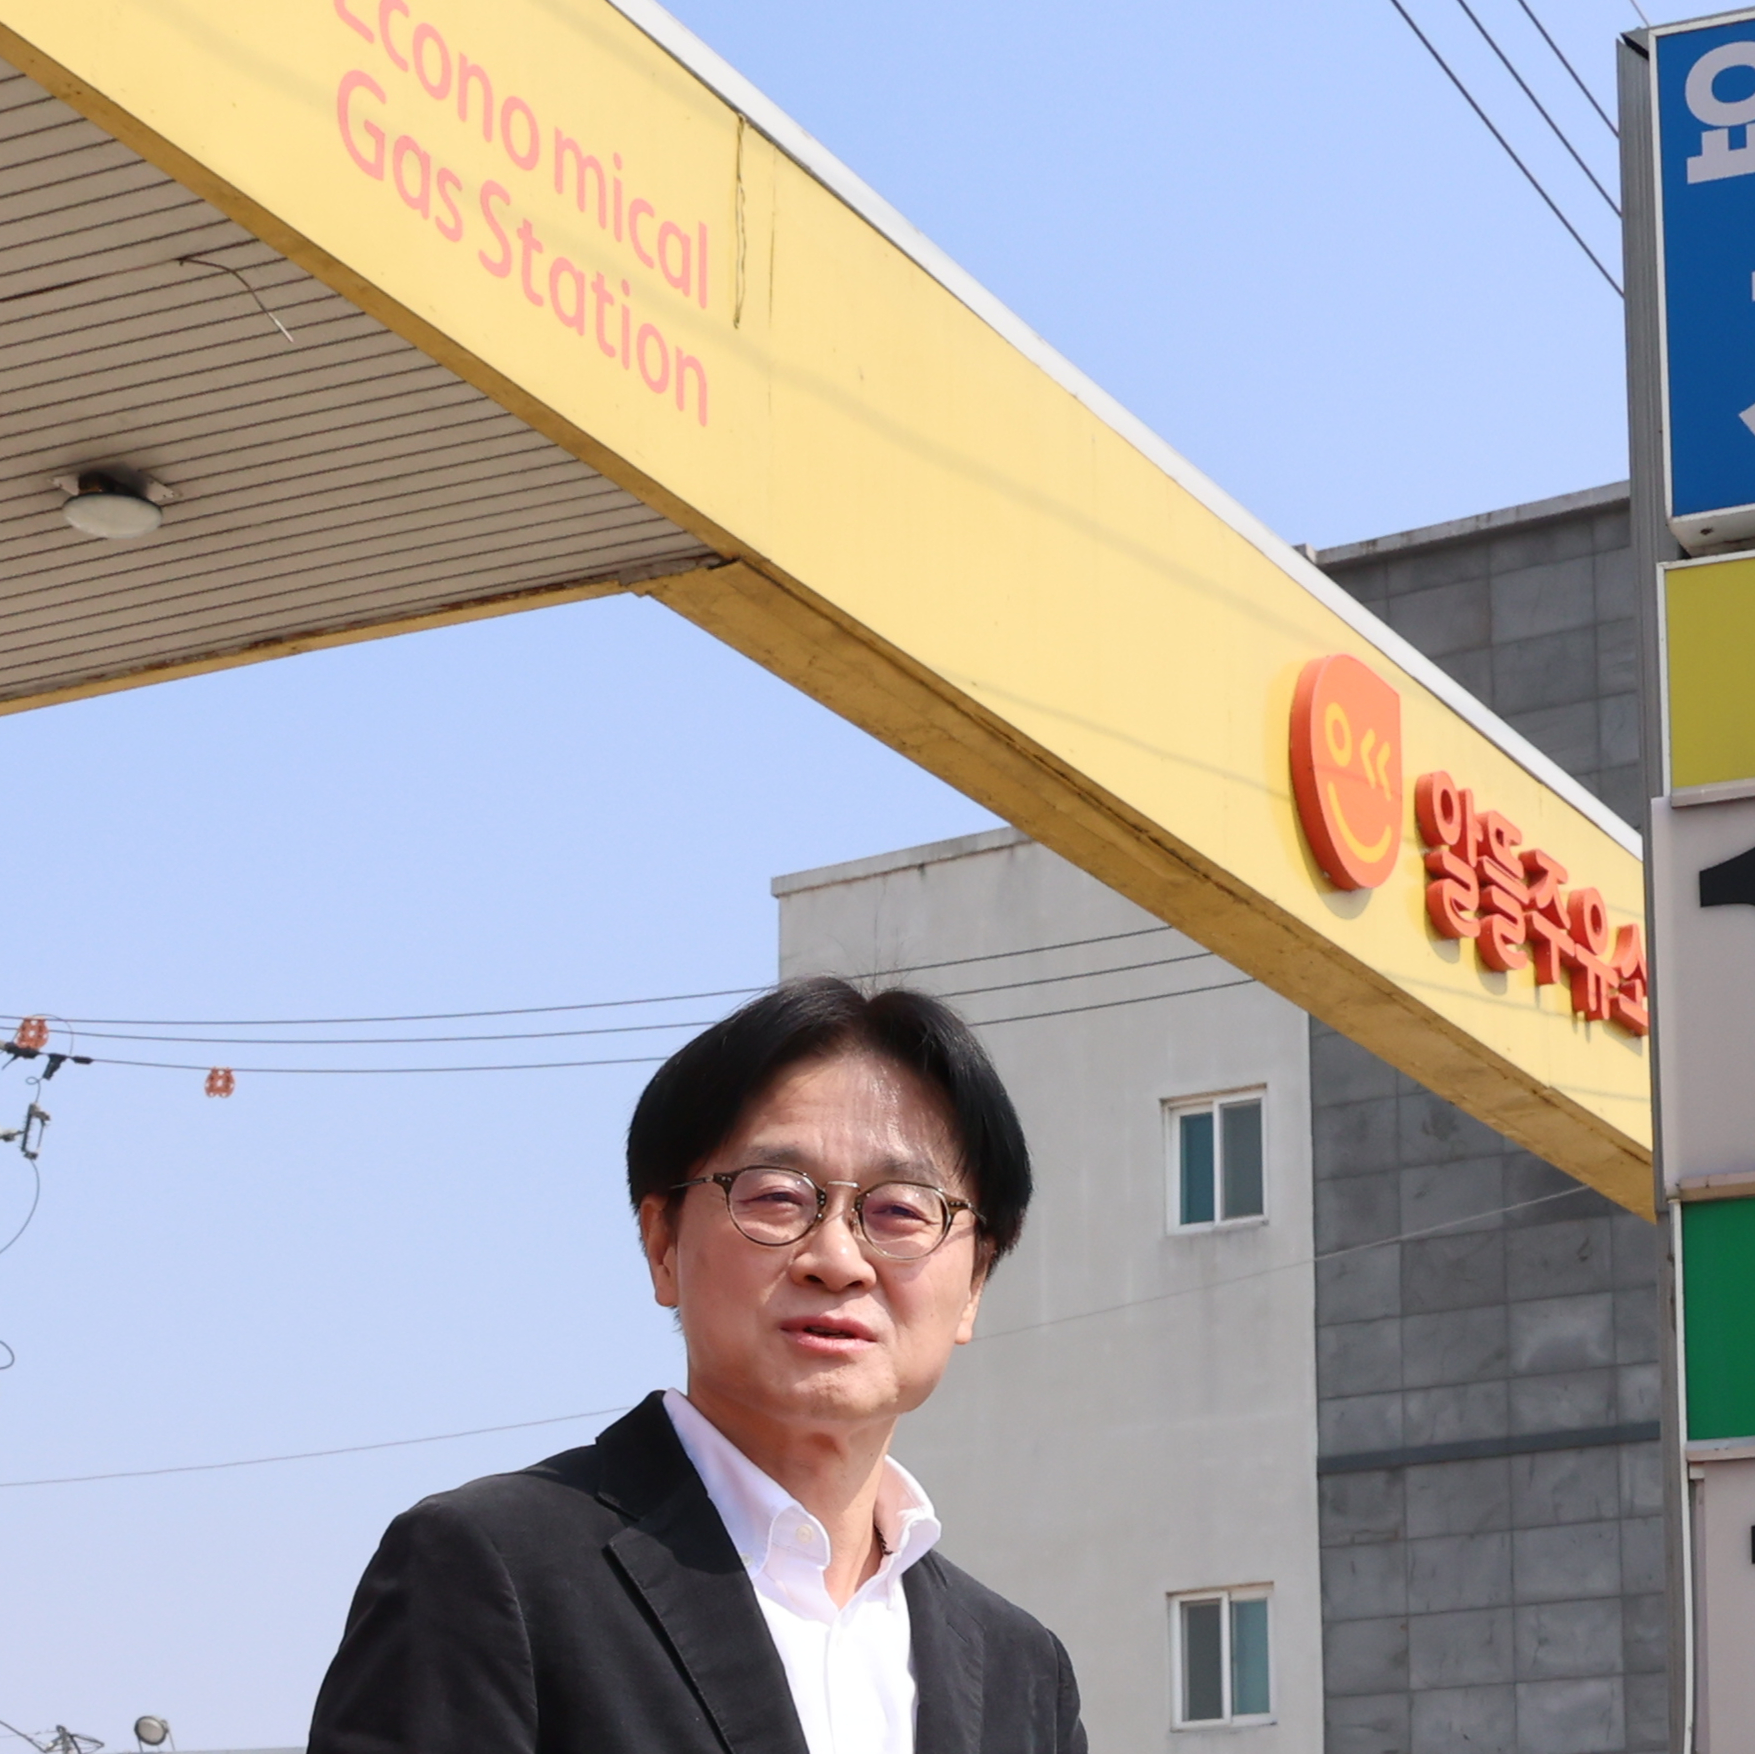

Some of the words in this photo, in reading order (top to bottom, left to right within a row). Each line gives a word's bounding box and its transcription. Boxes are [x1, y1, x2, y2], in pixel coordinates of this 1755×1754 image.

[337, 70, 463, 242] Gas
[478, 180, 707, 427] Station
[1415, 770, 1649, 1036] 알뜰주유소
